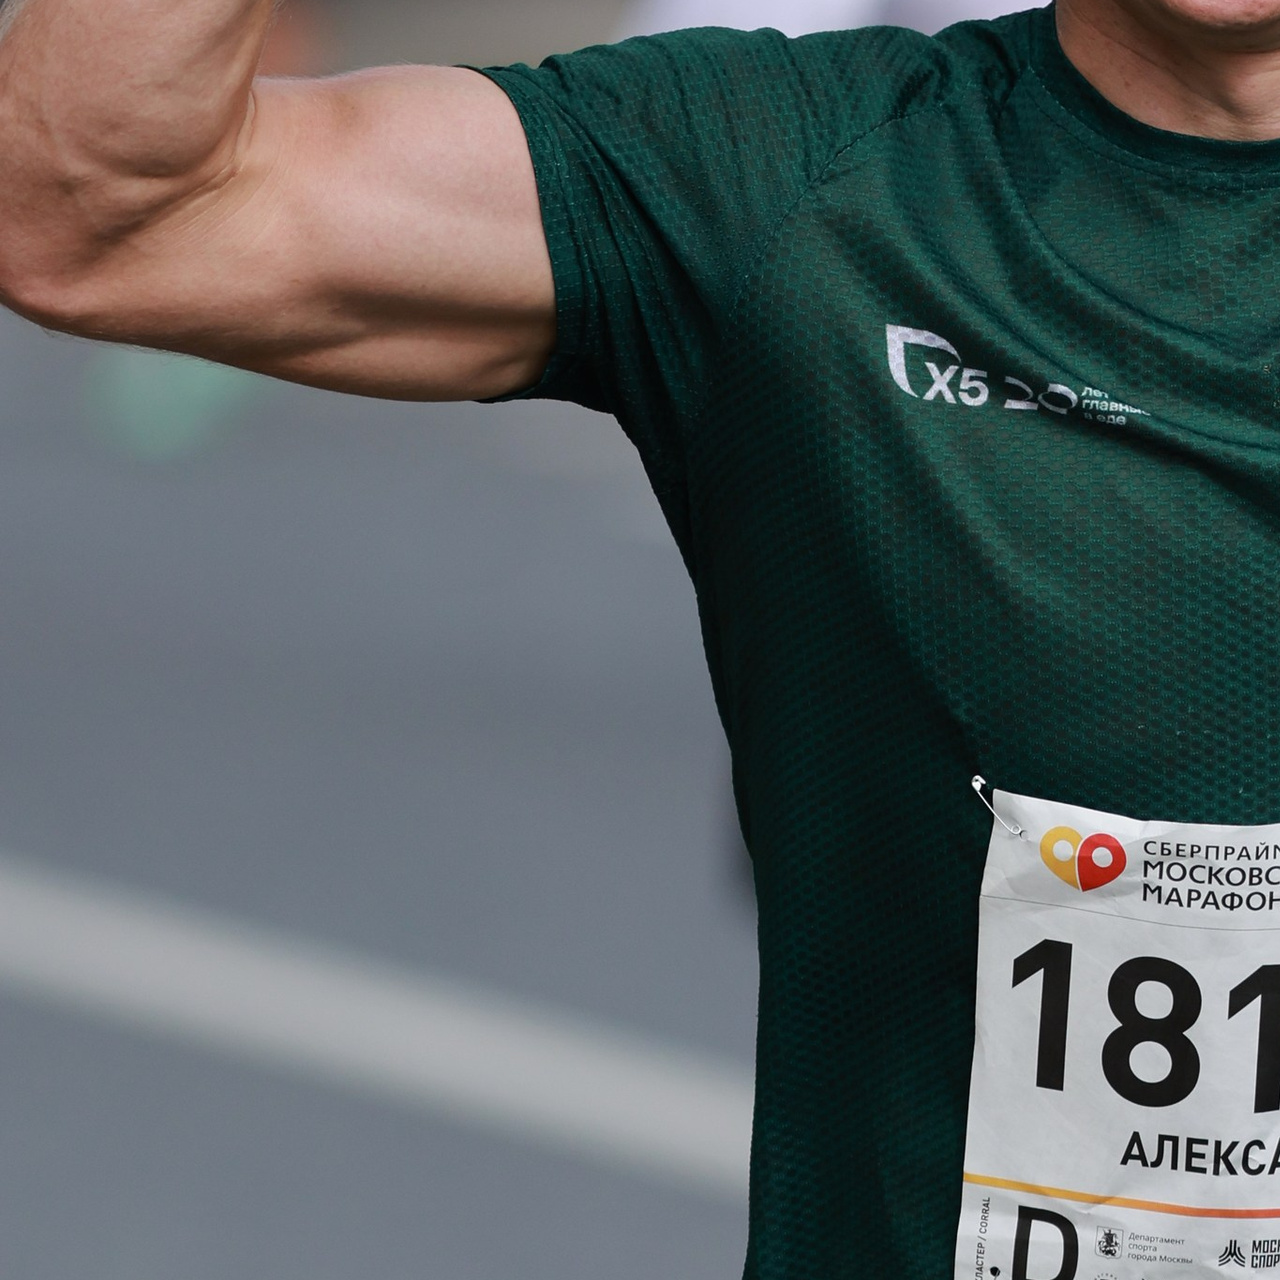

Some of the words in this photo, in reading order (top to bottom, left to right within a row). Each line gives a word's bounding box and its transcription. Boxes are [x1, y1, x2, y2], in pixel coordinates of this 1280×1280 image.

[923, 362, 988, 406] X5
[979, 1197, 990, 1234] CORRAL
[1128, 1232, 1185, 1245] Департамент
[1128, 1243, 1157, 1252] спорта
[1127, 1253, 1157, 1262] города
